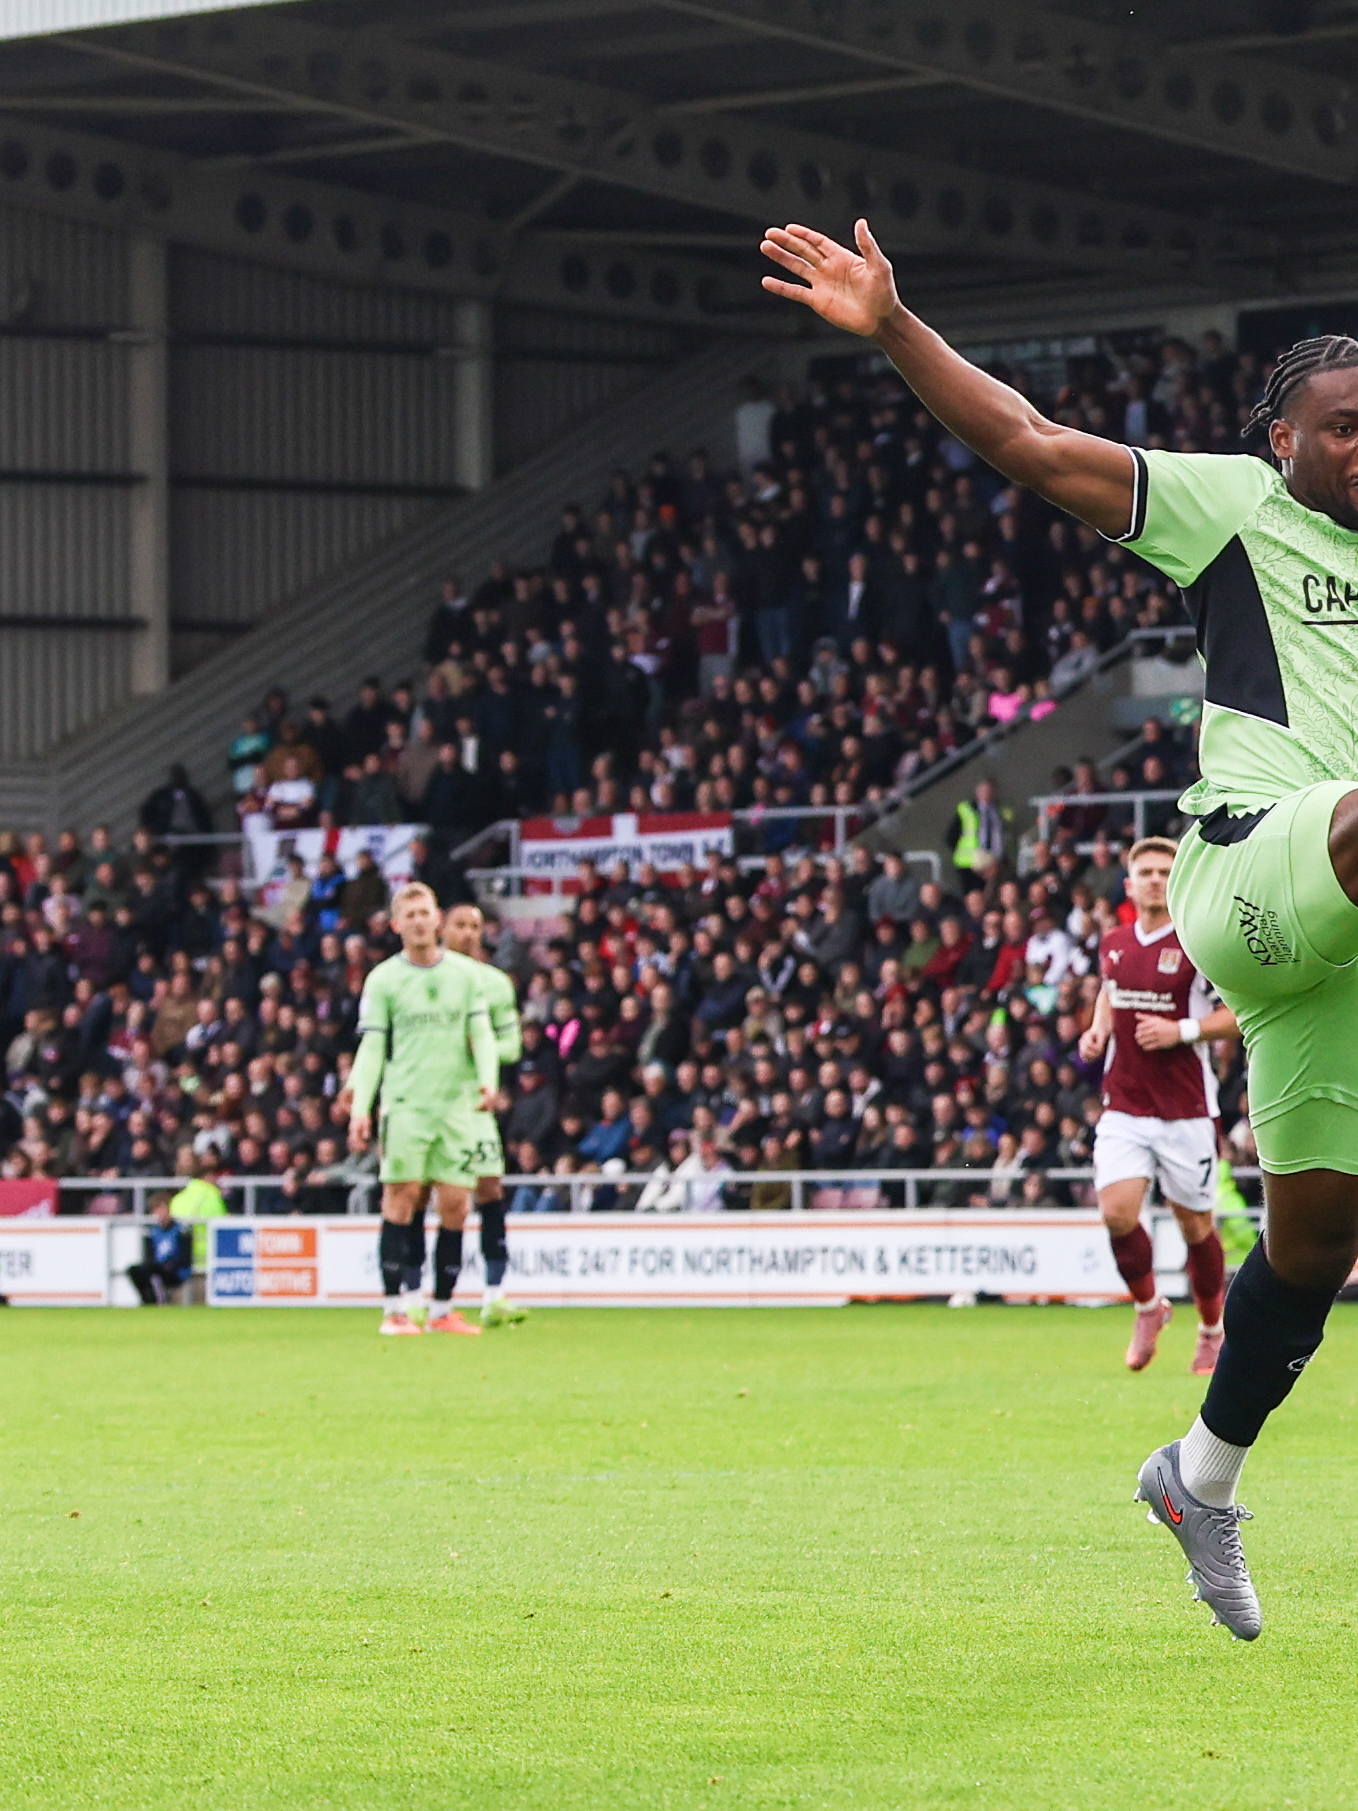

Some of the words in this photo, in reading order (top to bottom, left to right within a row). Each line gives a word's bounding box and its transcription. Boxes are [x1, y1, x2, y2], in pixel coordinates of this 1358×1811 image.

[1198, 1156, 1213, 1189] 7
[505, 1248, 571, 1278] NLINE
[628, 1248, 676, 1278] FOR
[684, 1247, 867, 1279] NORTHAMPTON
[899, 1246, 1037, 1277] KETTERING
